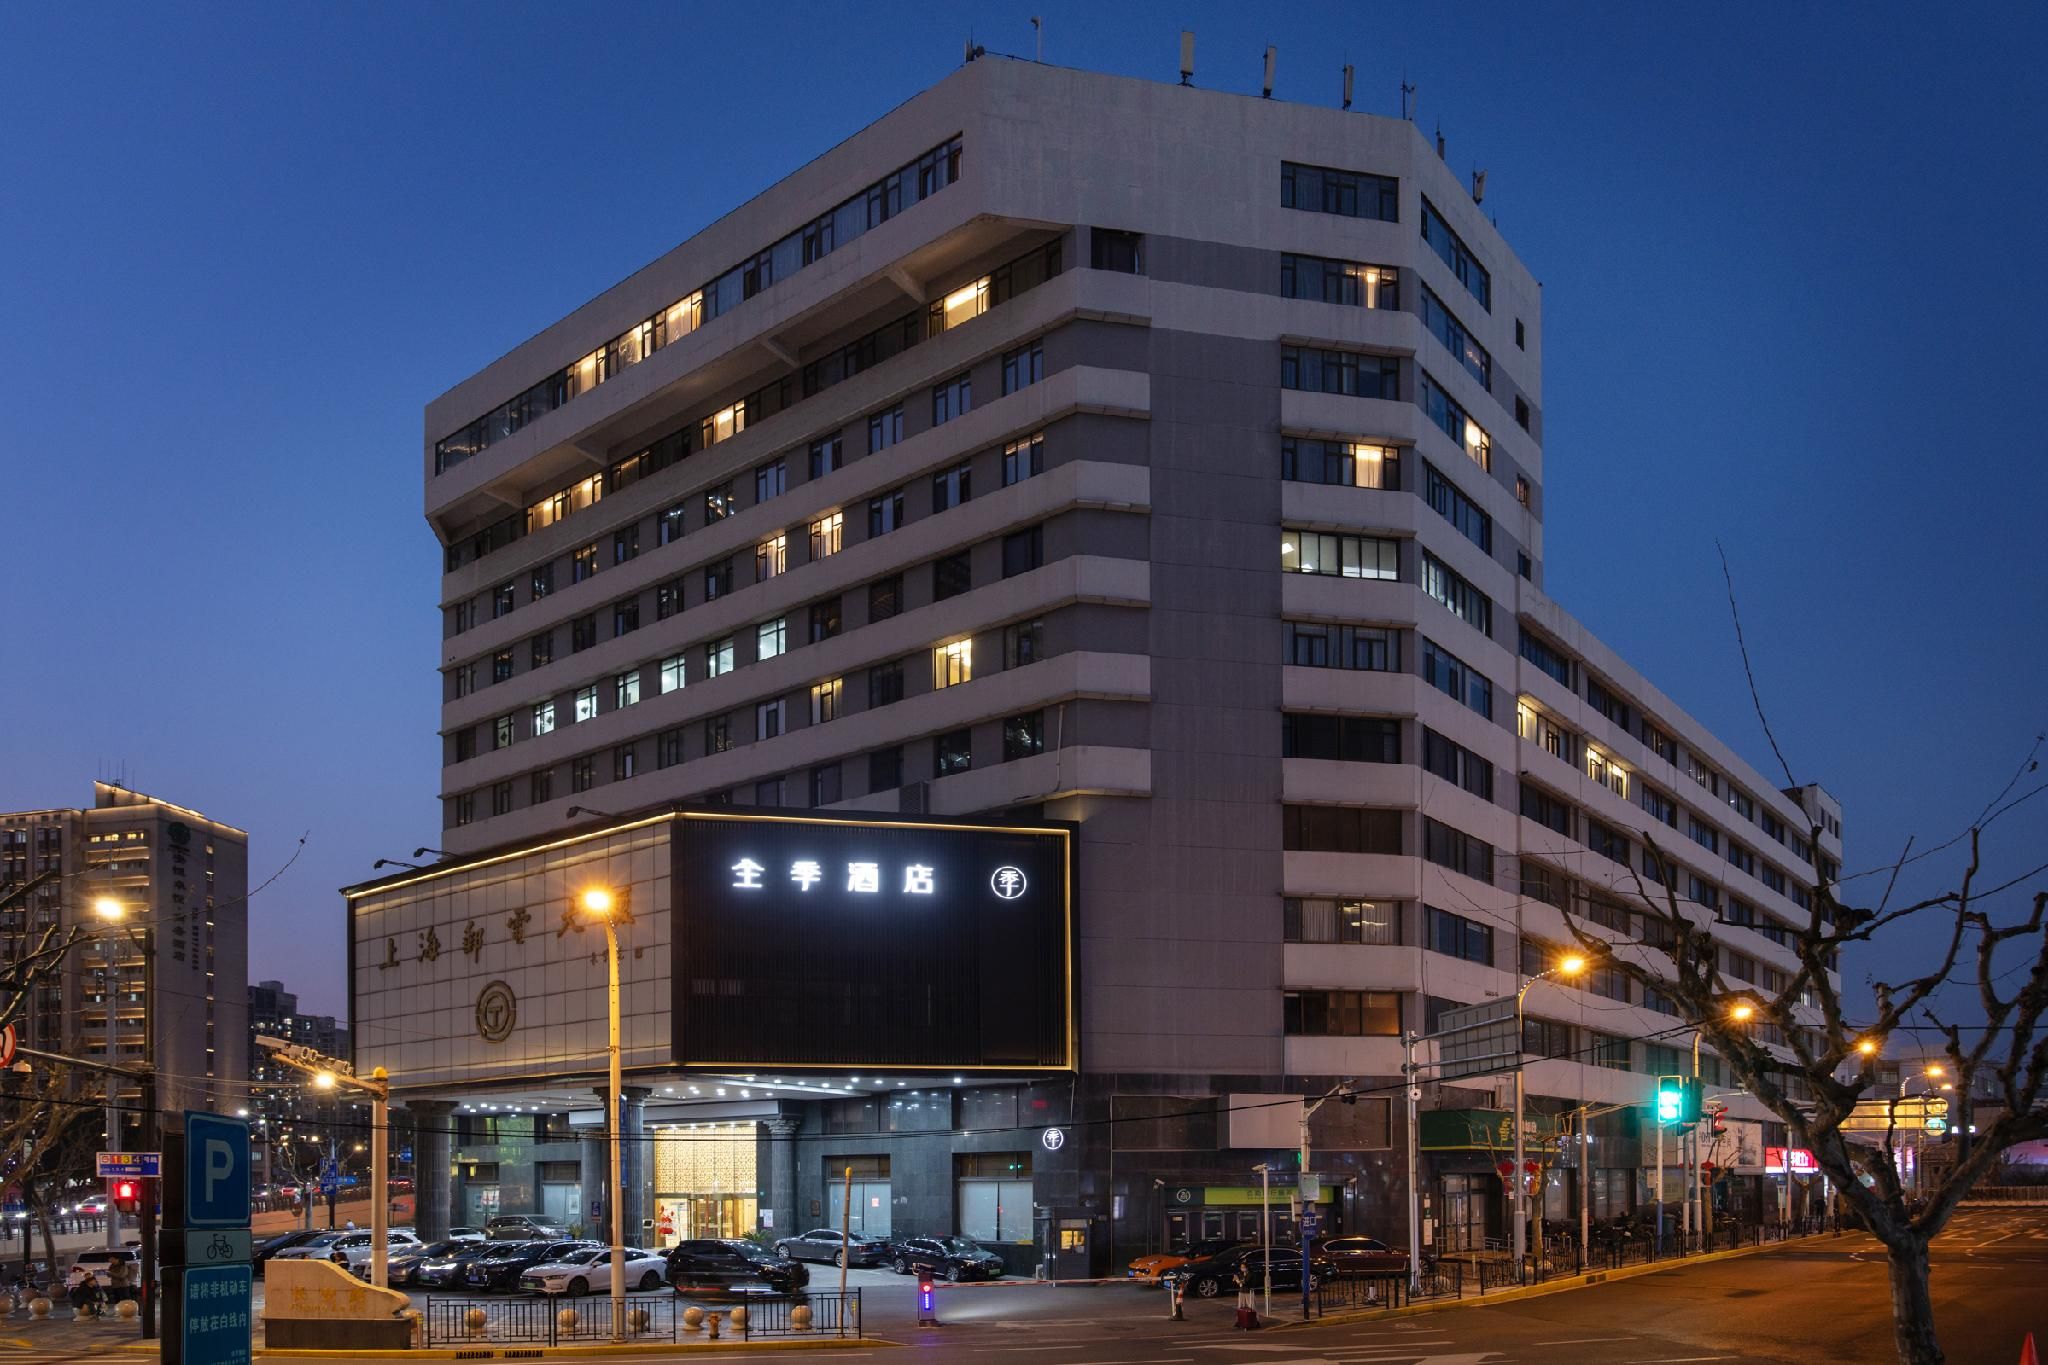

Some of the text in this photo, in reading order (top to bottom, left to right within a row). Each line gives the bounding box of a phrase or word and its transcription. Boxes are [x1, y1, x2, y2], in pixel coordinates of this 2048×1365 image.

[731, 858, 935, 894] 全季酒店
[206, 1138, 234, 1203] P
[189, 1279, 248, 1300] 请将非机动车
[189, 1311, 248, 1335] 停放在白线内
